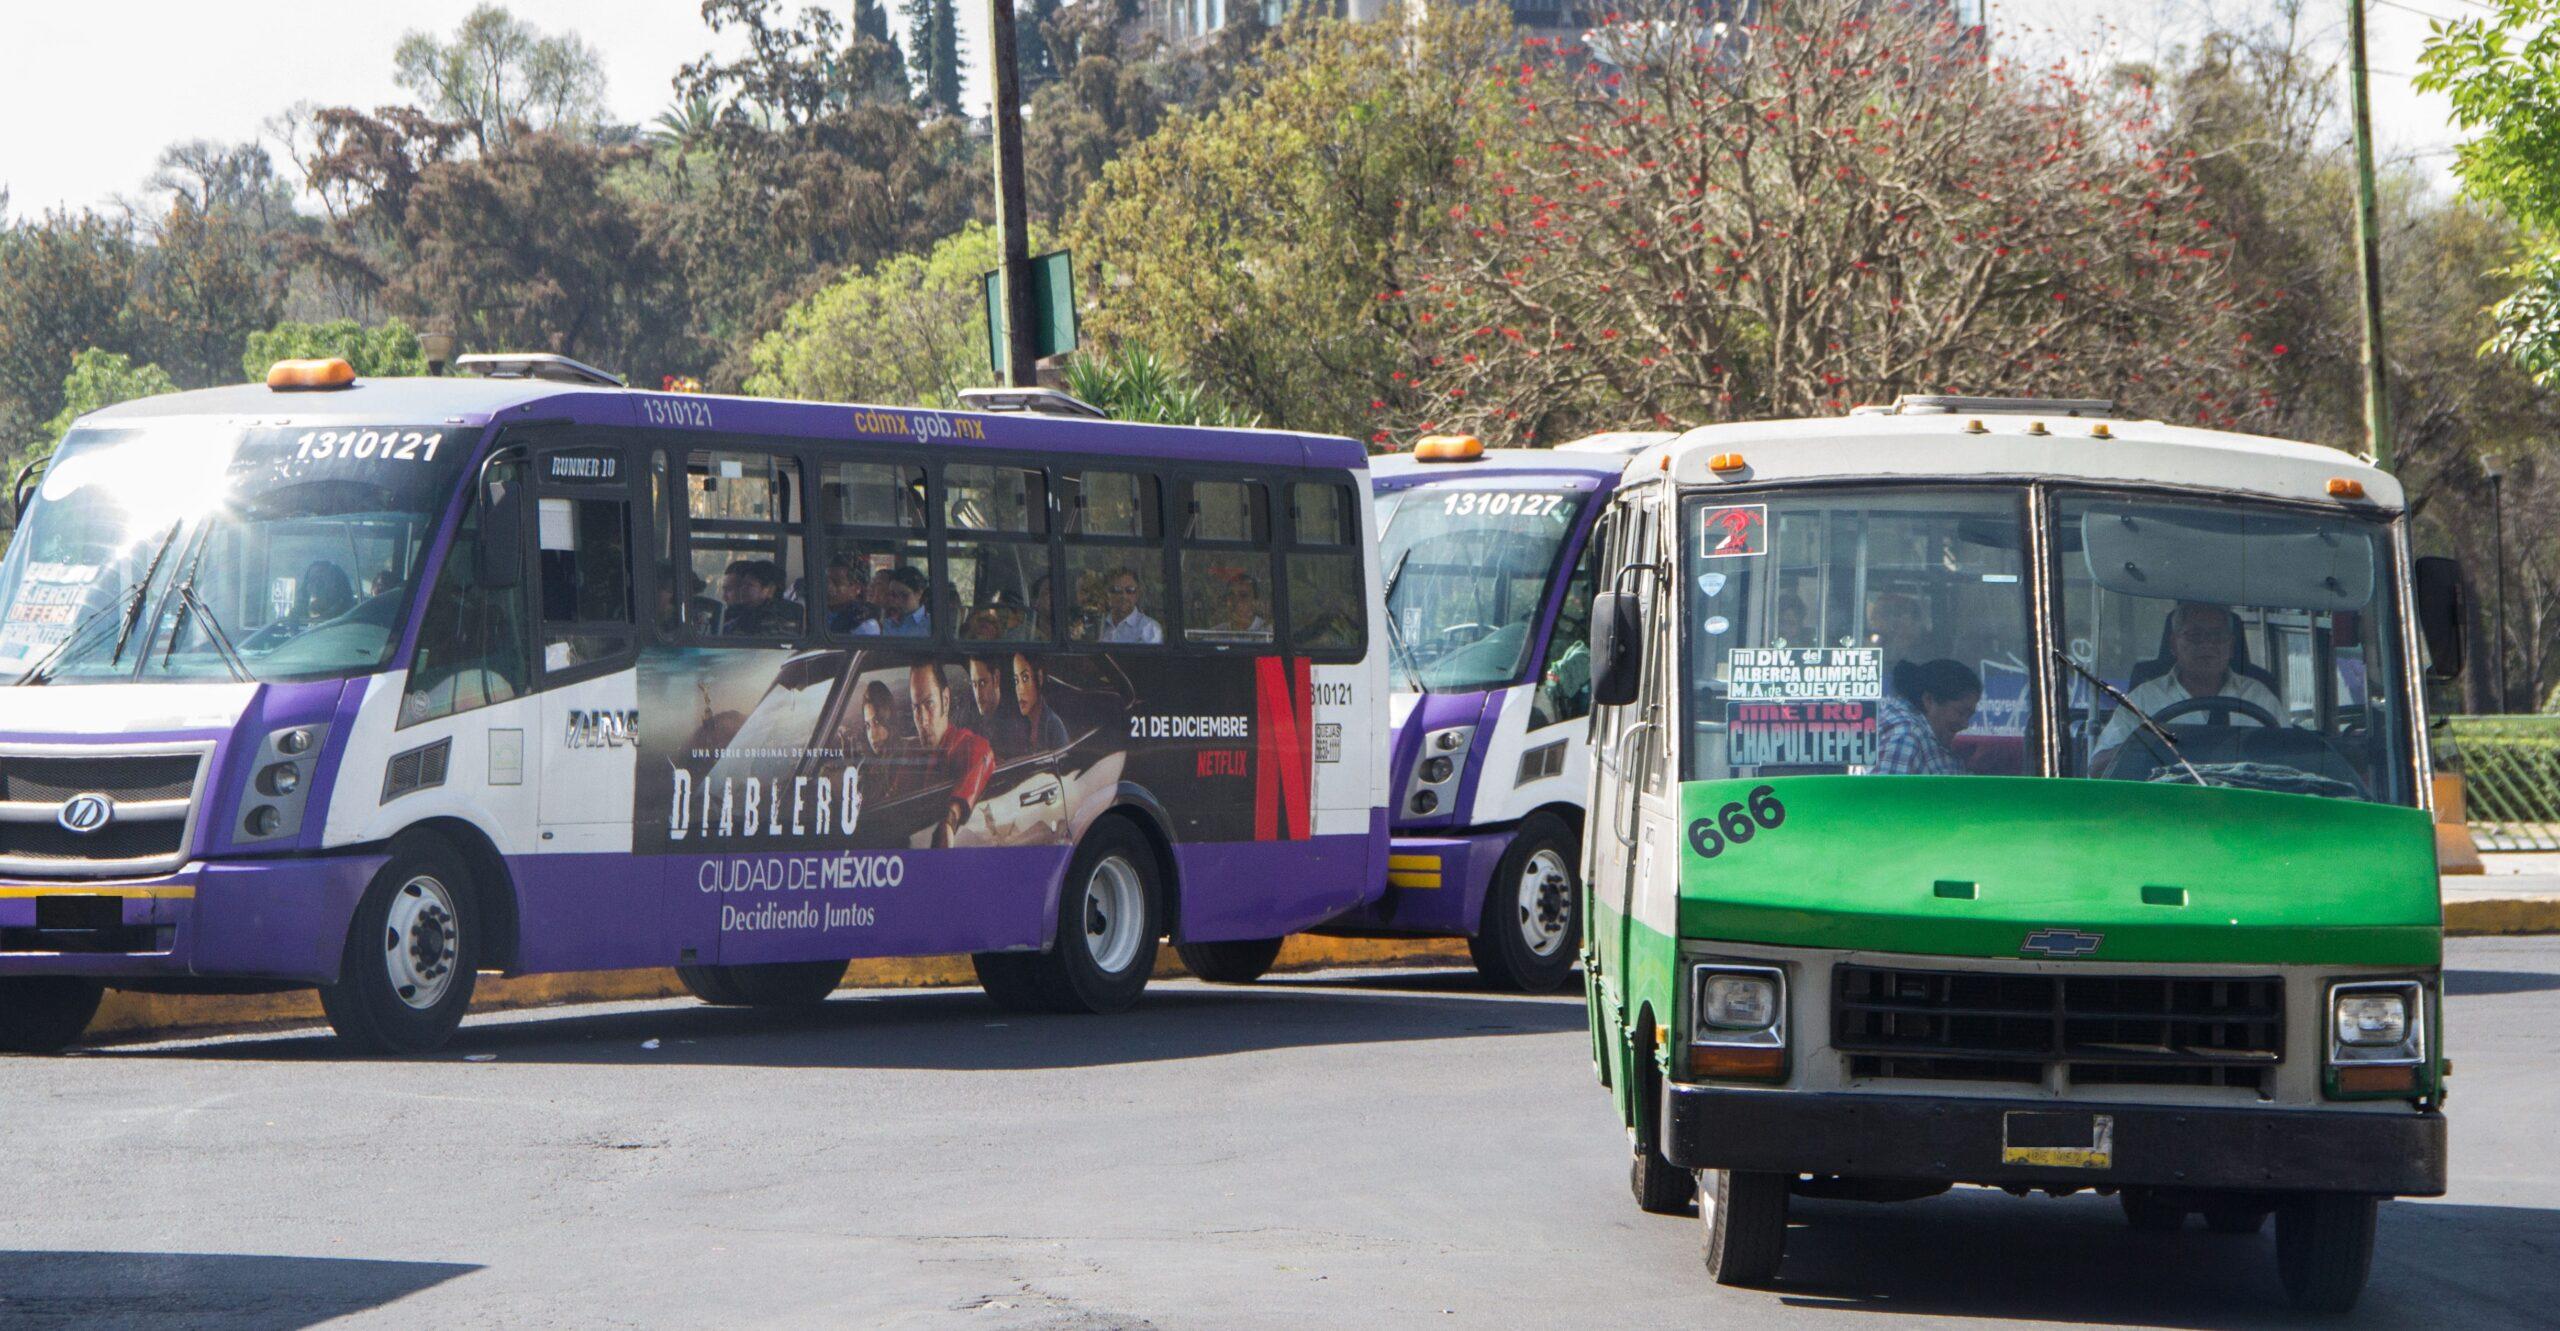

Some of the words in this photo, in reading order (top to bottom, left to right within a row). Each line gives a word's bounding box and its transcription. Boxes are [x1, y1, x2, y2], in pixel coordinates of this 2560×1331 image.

[643, 398, 713, 427] 1310121
[854, 408, 985, 443] cdmx.gob.mx
[297, 431, 442, 461] 1310121
[552, 456, 600, 477] RUNNER
[601, 457, 616, 477] 10
[1444, 492, 1563, 516] 1310127
[1757, 650, 1795, 666] DIV.
[1802, 648, 1822, 664] del
[1831, 650, 1878, 666] NTE.
[1733, 667, 1801, 683] ALBERCA
[1804, 665, 1877, 682] OLIMPICA
[1785, 681, 1880, 698] QUEVEDO
[1130, 716, 1146, 737] 21
[1150, 716, 1169, 737] DE
[1172, 715, 1248, 737] DICIEMBRE
[1739, 703, 1864, 721] METRO
[692, 748, 710, 758] UNA
[714, 748, 741, 758] SERIE
[745, 748, 788, 758] ORIGINAL
[792, 748, 804, 758] DE
[806, 748, 844, 758] NETFLIX
[1254, 656, 1312, 841] N
[1730, 717, 1876, 765] CHAPULTEPEC
[1197, 750, 1247, 778] NETFLIX
[668, 760, 863, 840] DIABLERO
[1688, 785, 1785, 859] 666
[698, 859, 784, 892] CIUDAD
[788, 858, 818, 890] DE
[820, 850, 904, 889] MÉXICO
[721, 901, 819, 931] Decidiendo
[823, 902, 875, 932] Juntos
